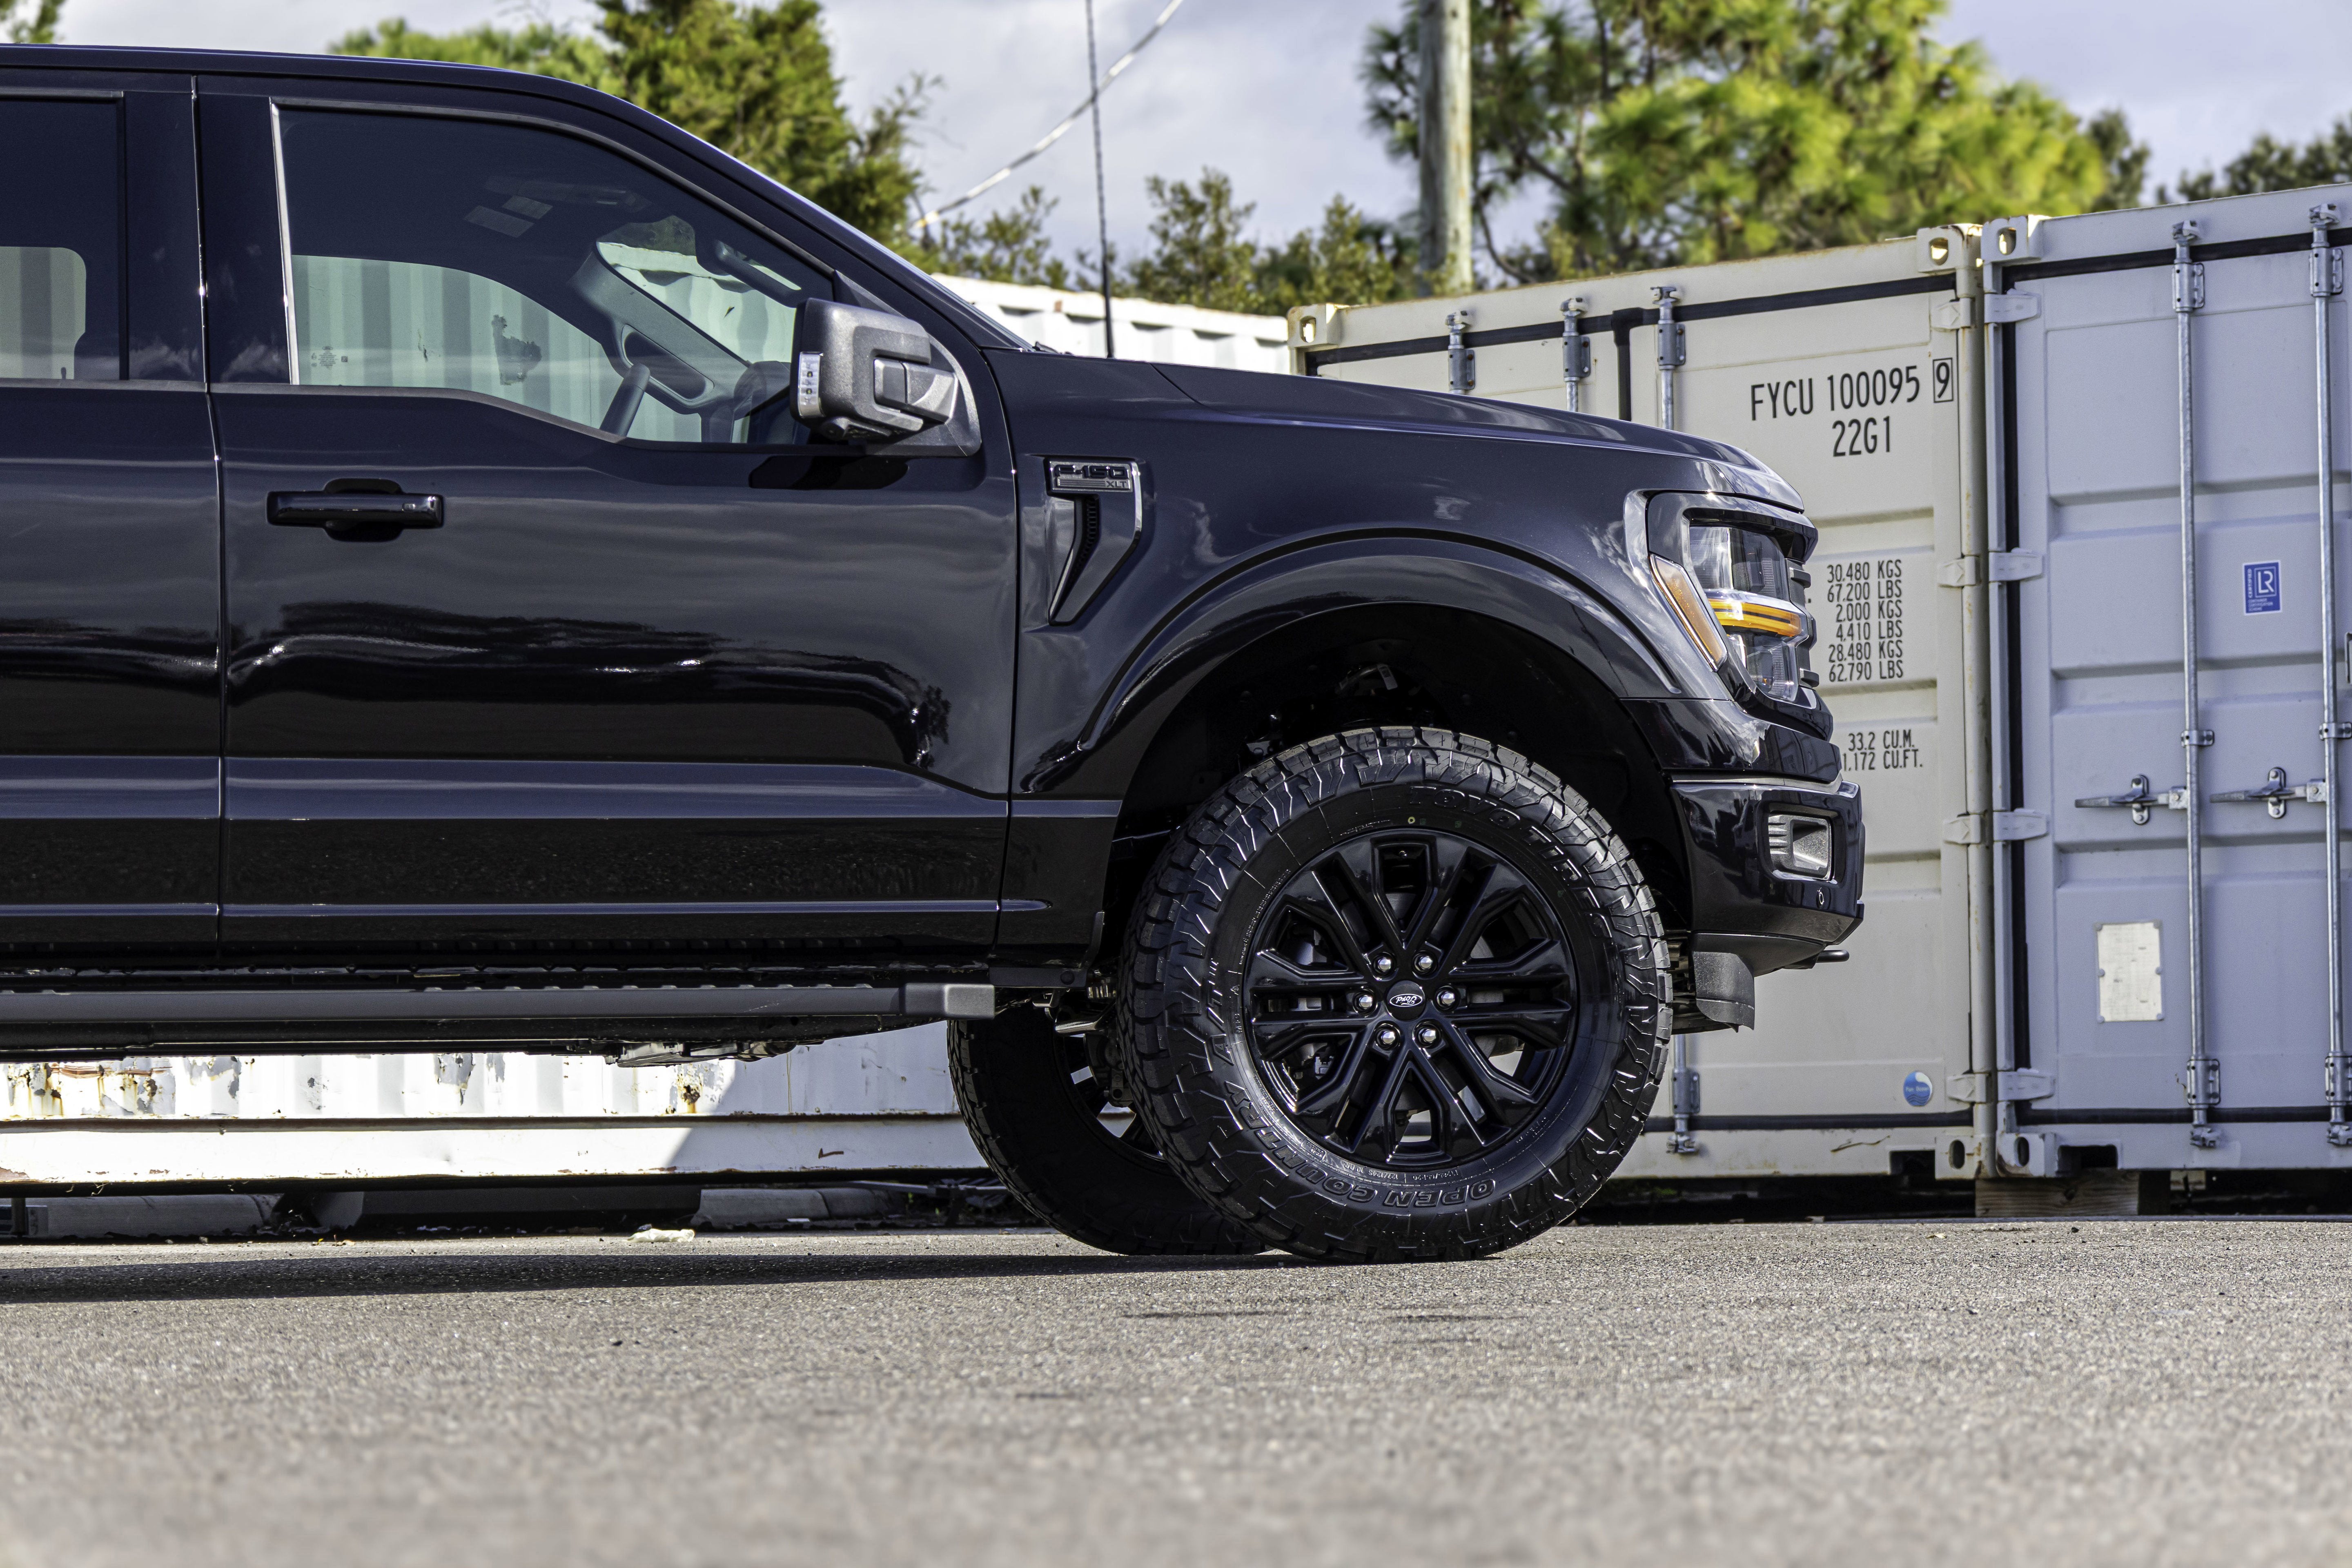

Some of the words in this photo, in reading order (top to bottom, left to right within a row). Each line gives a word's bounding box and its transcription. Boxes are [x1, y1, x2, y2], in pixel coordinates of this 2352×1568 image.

[1751, 378, 1813, 421] FYCU
[1827, 365, 1920, 412] 100095
[1936, 362, 1950, 399] 9
[1832, 416, 1891, 457] 22G1
[1054, 464, 1129, 480] F-150
[1106, 480, 1127, 488] XLT
[1877, 559, 1902, 579] KGS
[1878, 579, 1902, 599] LBS
[2257, 570, 2274, 594] LR
[1878, 599, 1902, 619] KGS
[1878, 620, 1903, 640] LBS
[1879, 640, 1903, 659] KGS
[1879, 660, 1903, 680] LBS
[1848, 731, 1875, 752] 33.2
[1883, 729, 1915, 749] CU.M.
[1883, 749, 1923, 769] CU.FT.
[1408, 786, 1521, 829] TOYO
[1395, 995, 1417, 1006] Ford
[1225, 1080, 1378, 1203] COUNTRY
[1383, 1178, 1495, 1207] OPEN
